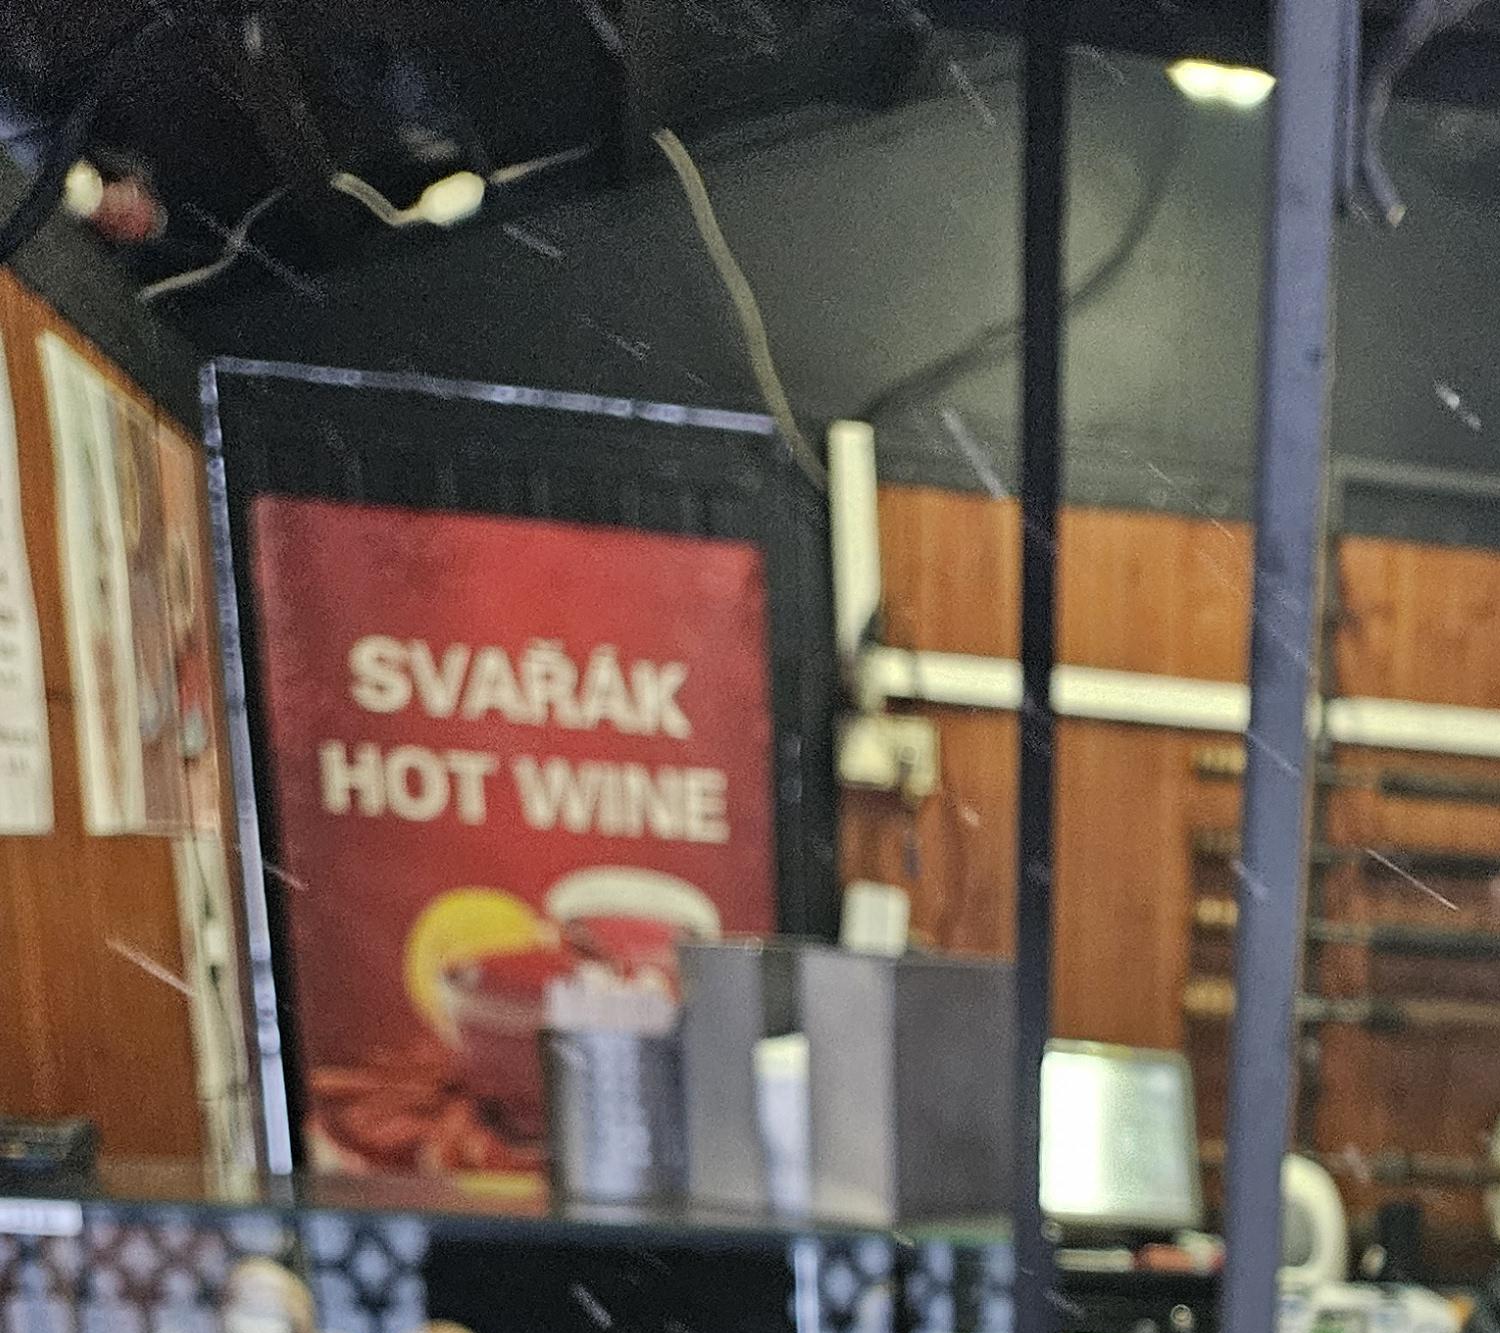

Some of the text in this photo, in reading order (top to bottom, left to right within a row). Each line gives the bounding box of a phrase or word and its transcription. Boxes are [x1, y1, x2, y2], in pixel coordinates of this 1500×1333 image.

[349, 634, 692, 738] SVAŘÁK
[319, 740, 729, 843] HOT WINE
